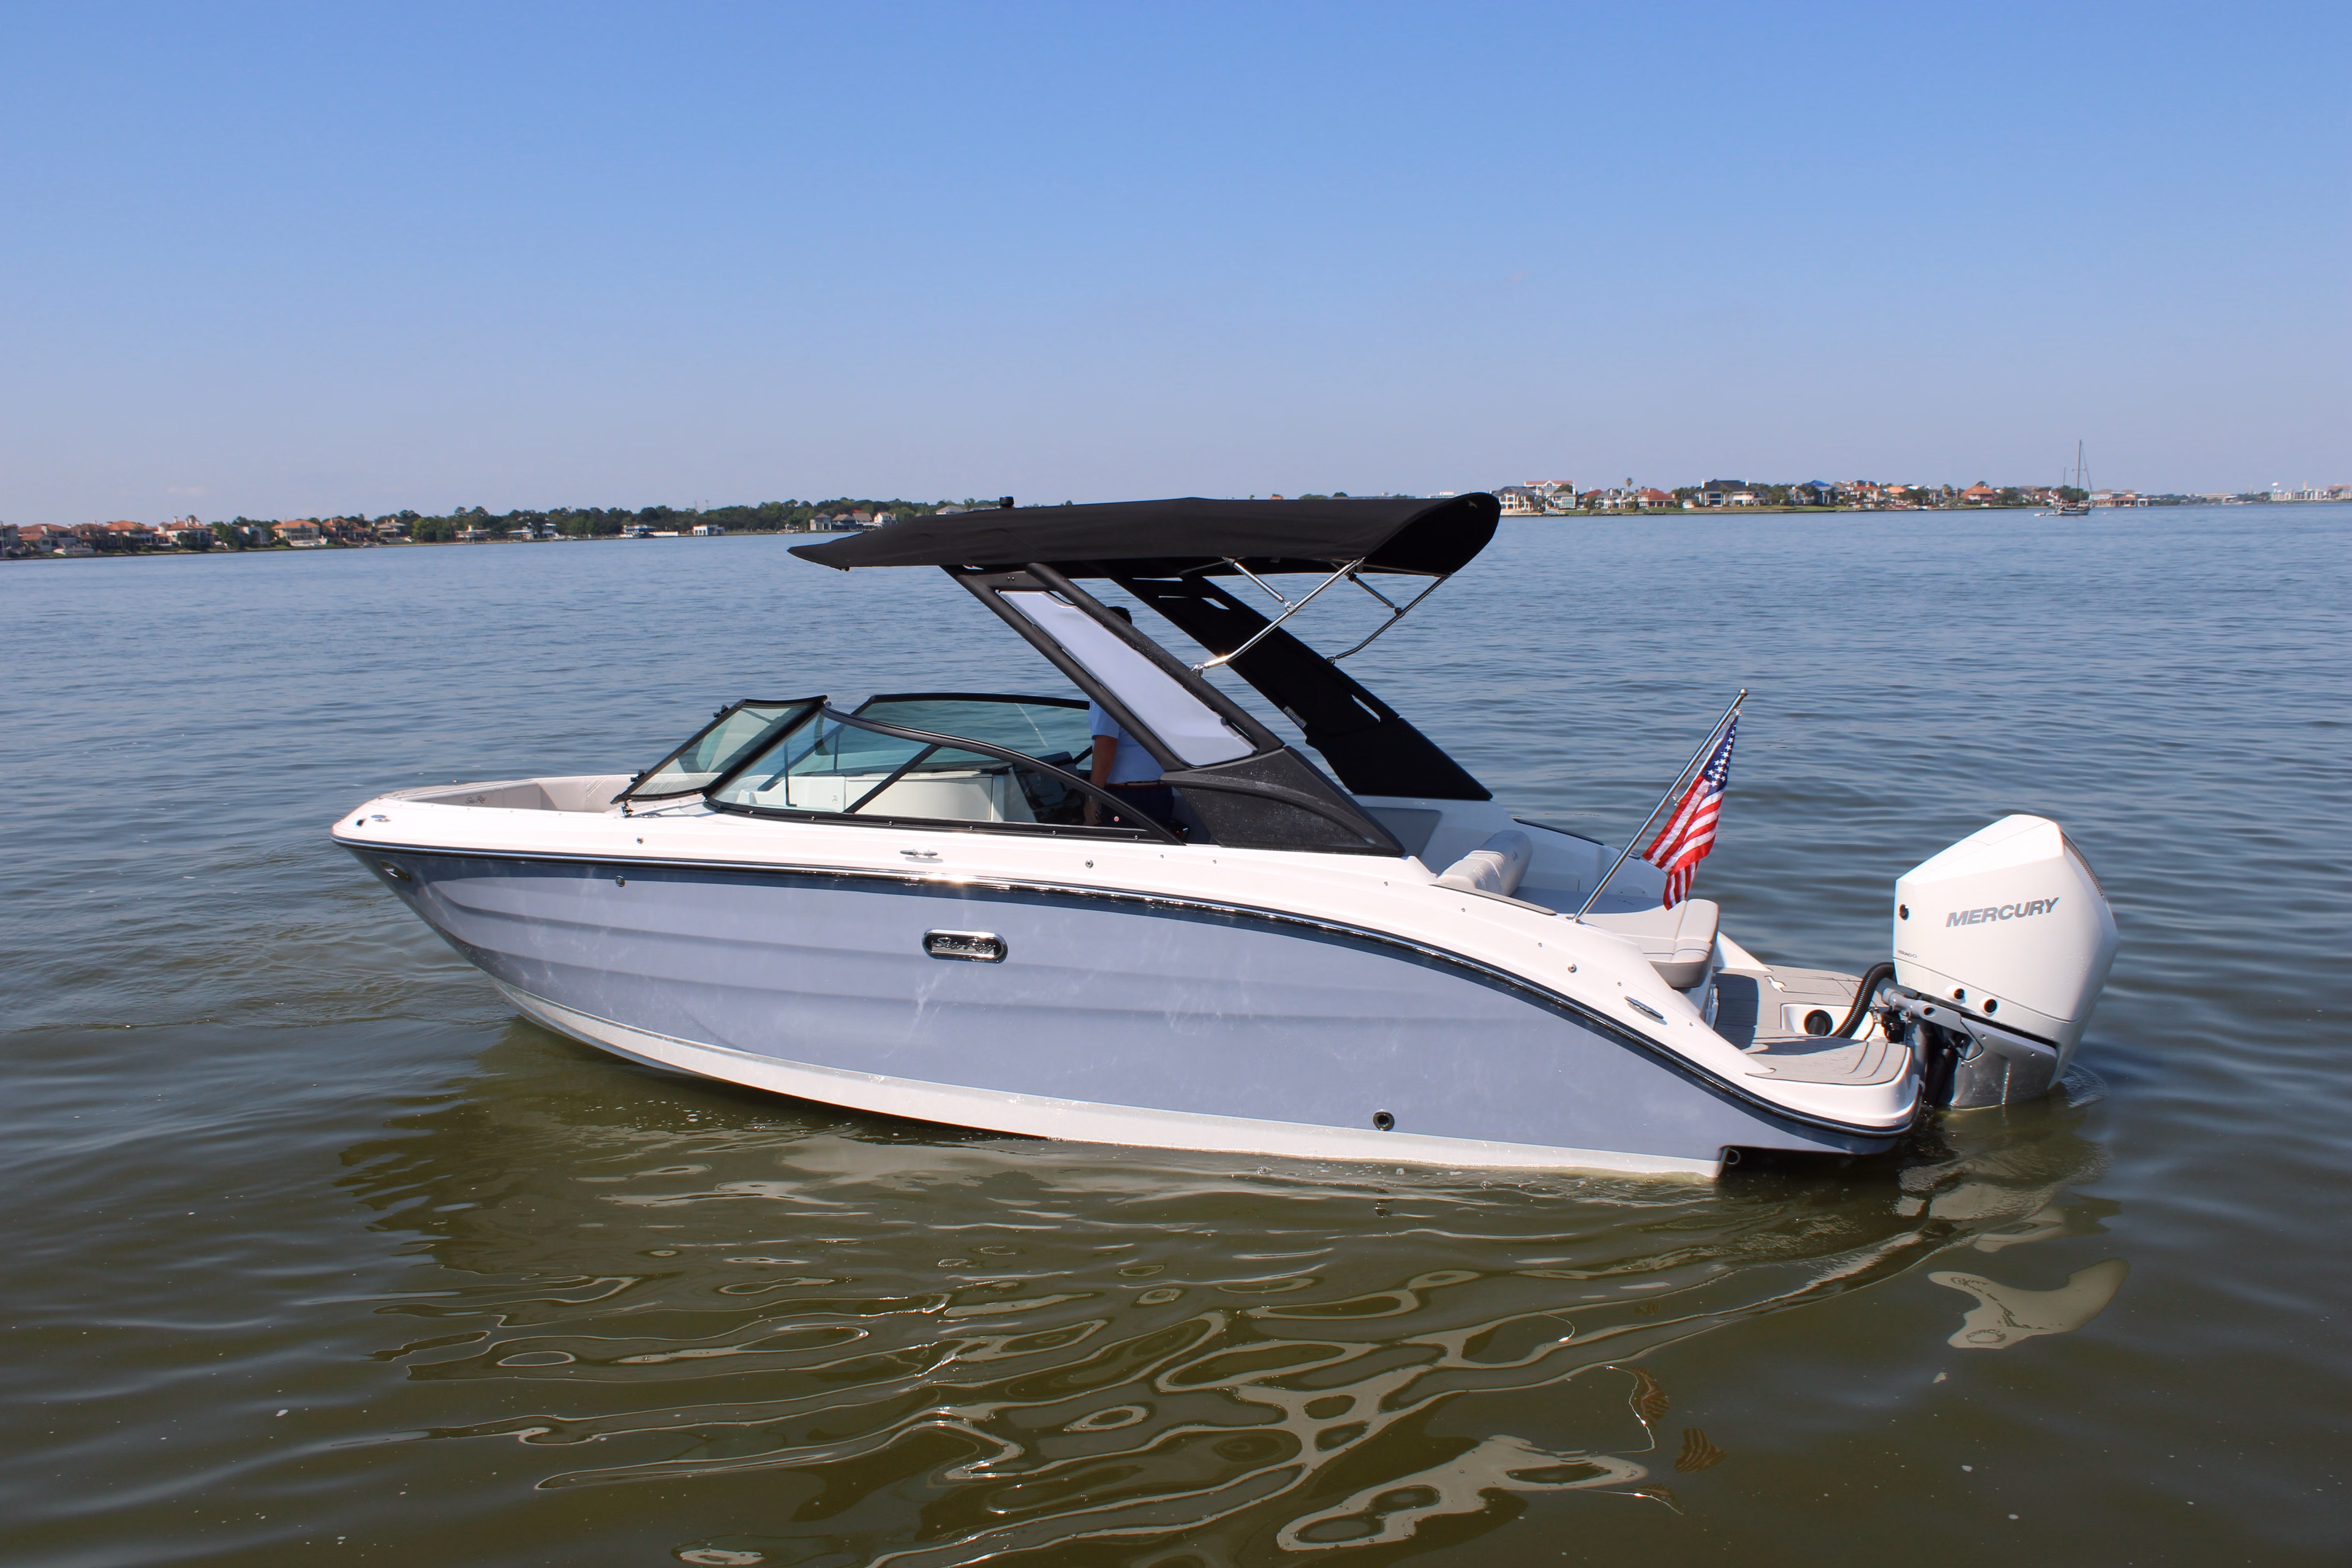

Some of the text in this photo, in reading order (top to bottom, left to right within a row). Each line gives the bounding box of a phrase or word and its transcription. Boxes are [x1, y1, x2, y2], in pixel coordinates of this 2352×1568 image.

[1945, 897, 2059, 927] MERCURY
[931, 937, 996, 954] Sea Ray
